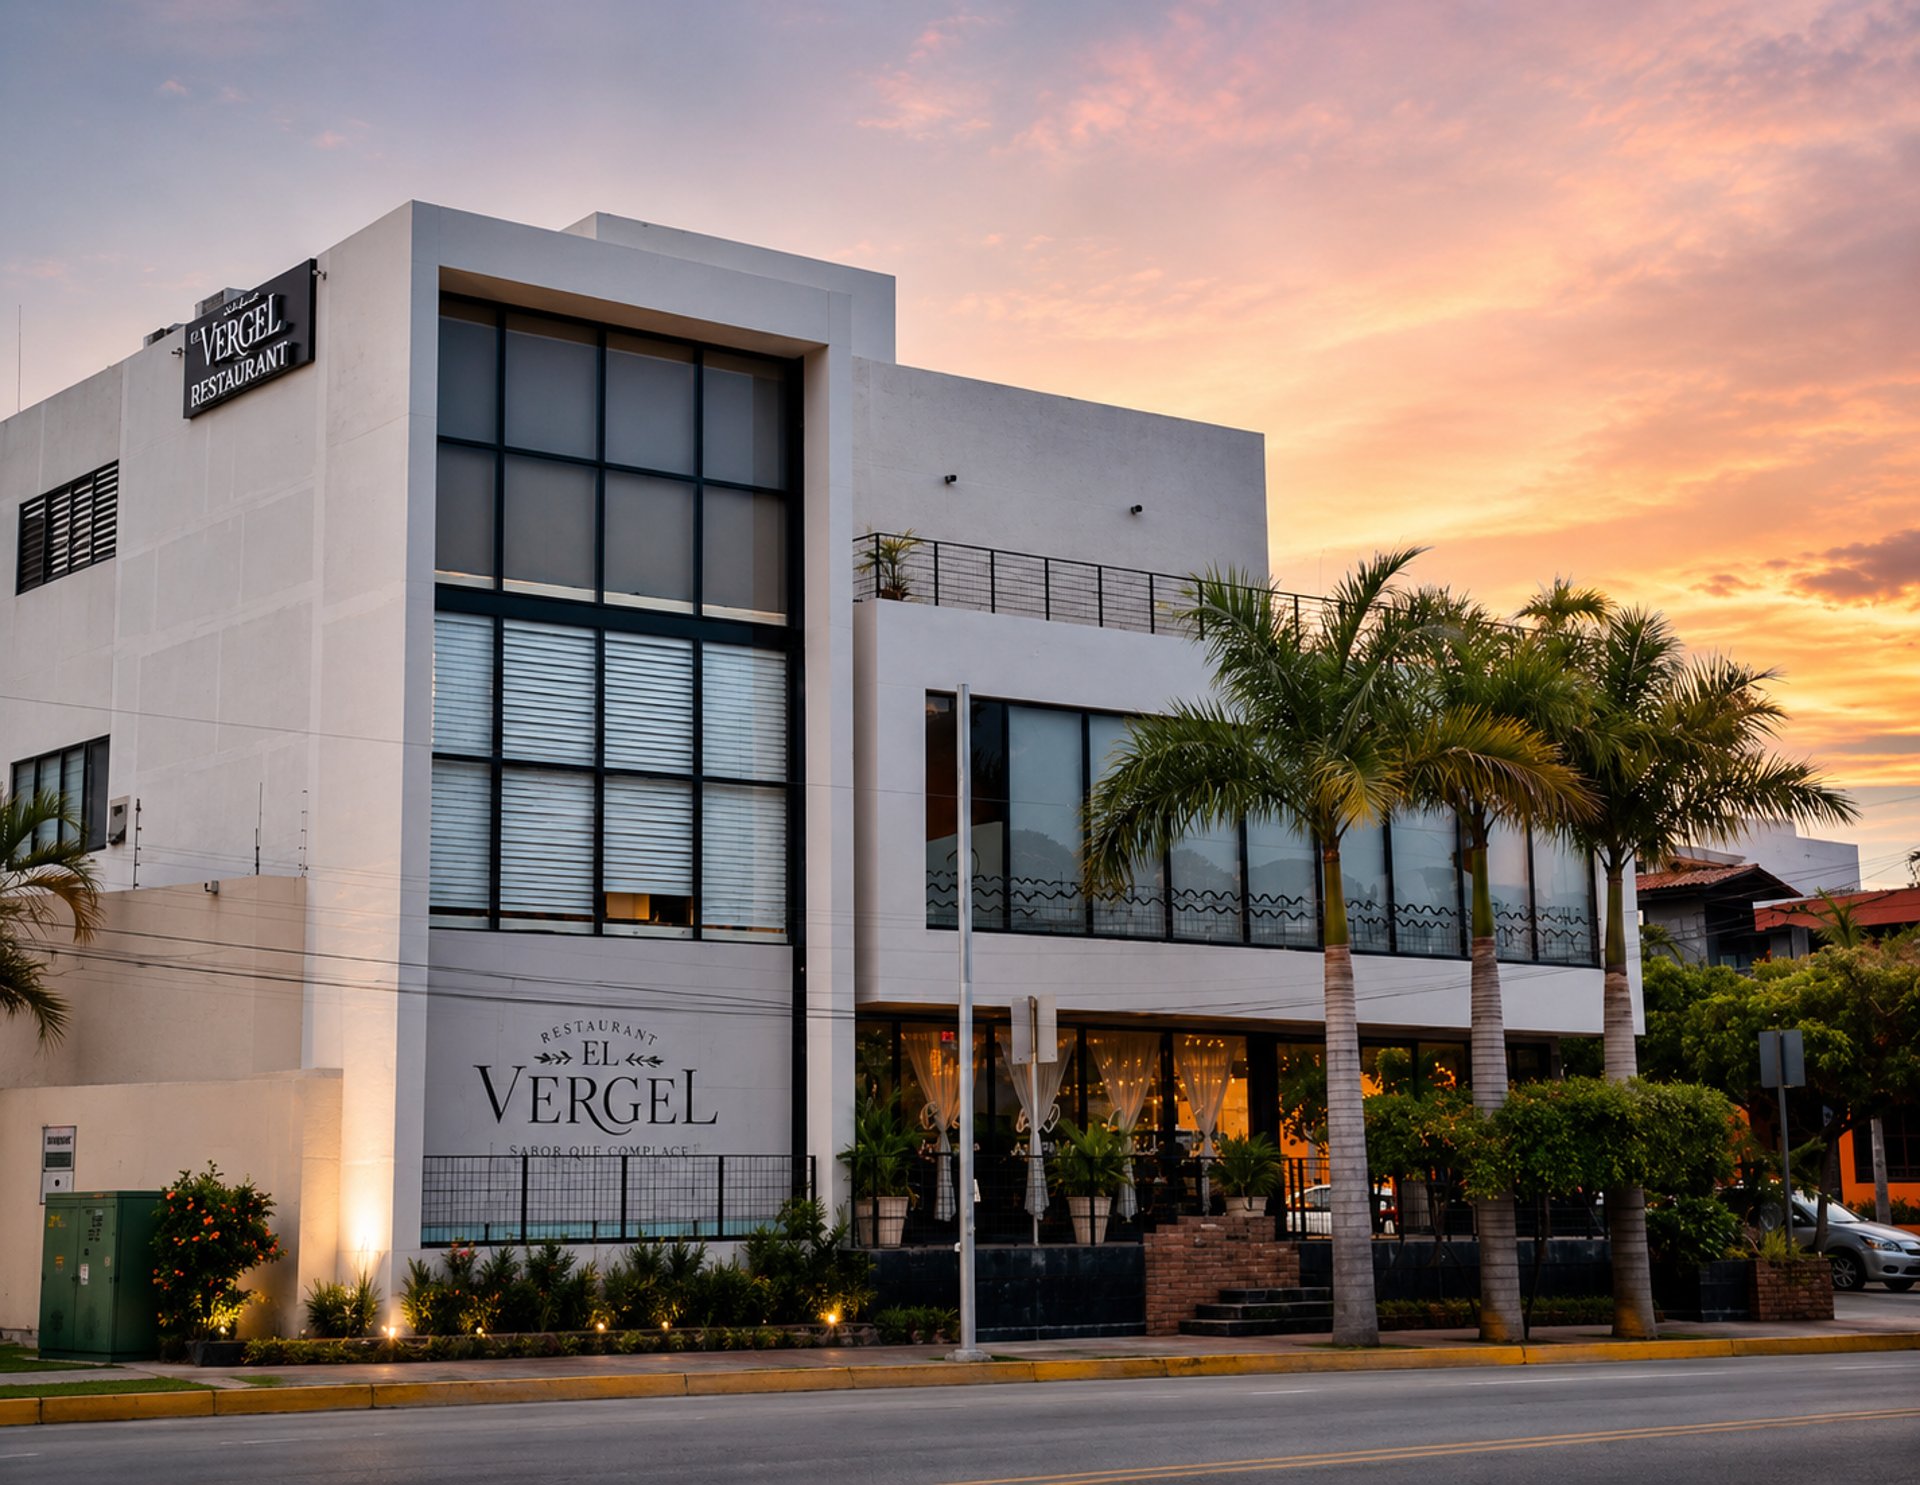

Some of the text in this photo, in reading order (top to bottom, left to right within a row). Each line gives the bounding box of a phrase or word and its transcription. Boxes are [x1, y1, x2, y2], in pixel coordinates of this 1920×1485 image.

[200, 293, 281, 366] VERGEL
[191, 341, 288, 408] RESTAURANT
[540, 1019, 658, 1046] RESTAURANT
[581, 1040, 619, 1066] EL
[473, 1065, 718, 1135] VERGEL
